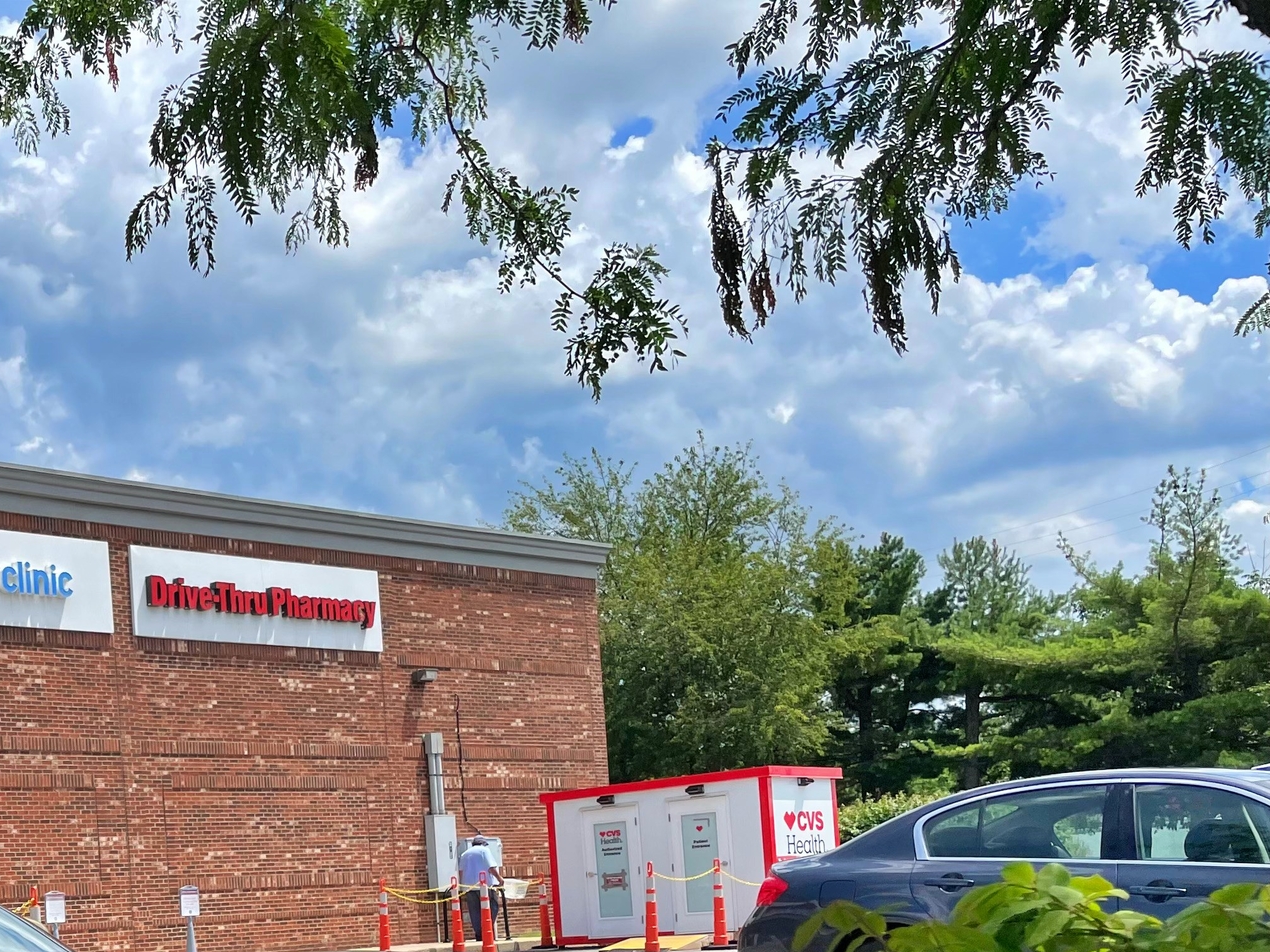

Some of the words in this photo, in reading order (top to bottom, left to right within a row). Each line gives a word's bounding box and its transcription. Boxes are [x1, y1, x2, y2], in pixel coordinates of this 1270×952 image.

[145, 575, 269, 616] Drive-Thru
[269, 586, 377, 630] Pharmacy
[797, 811, 824, 831] CVS
[786, 834, 826, 855] Health
